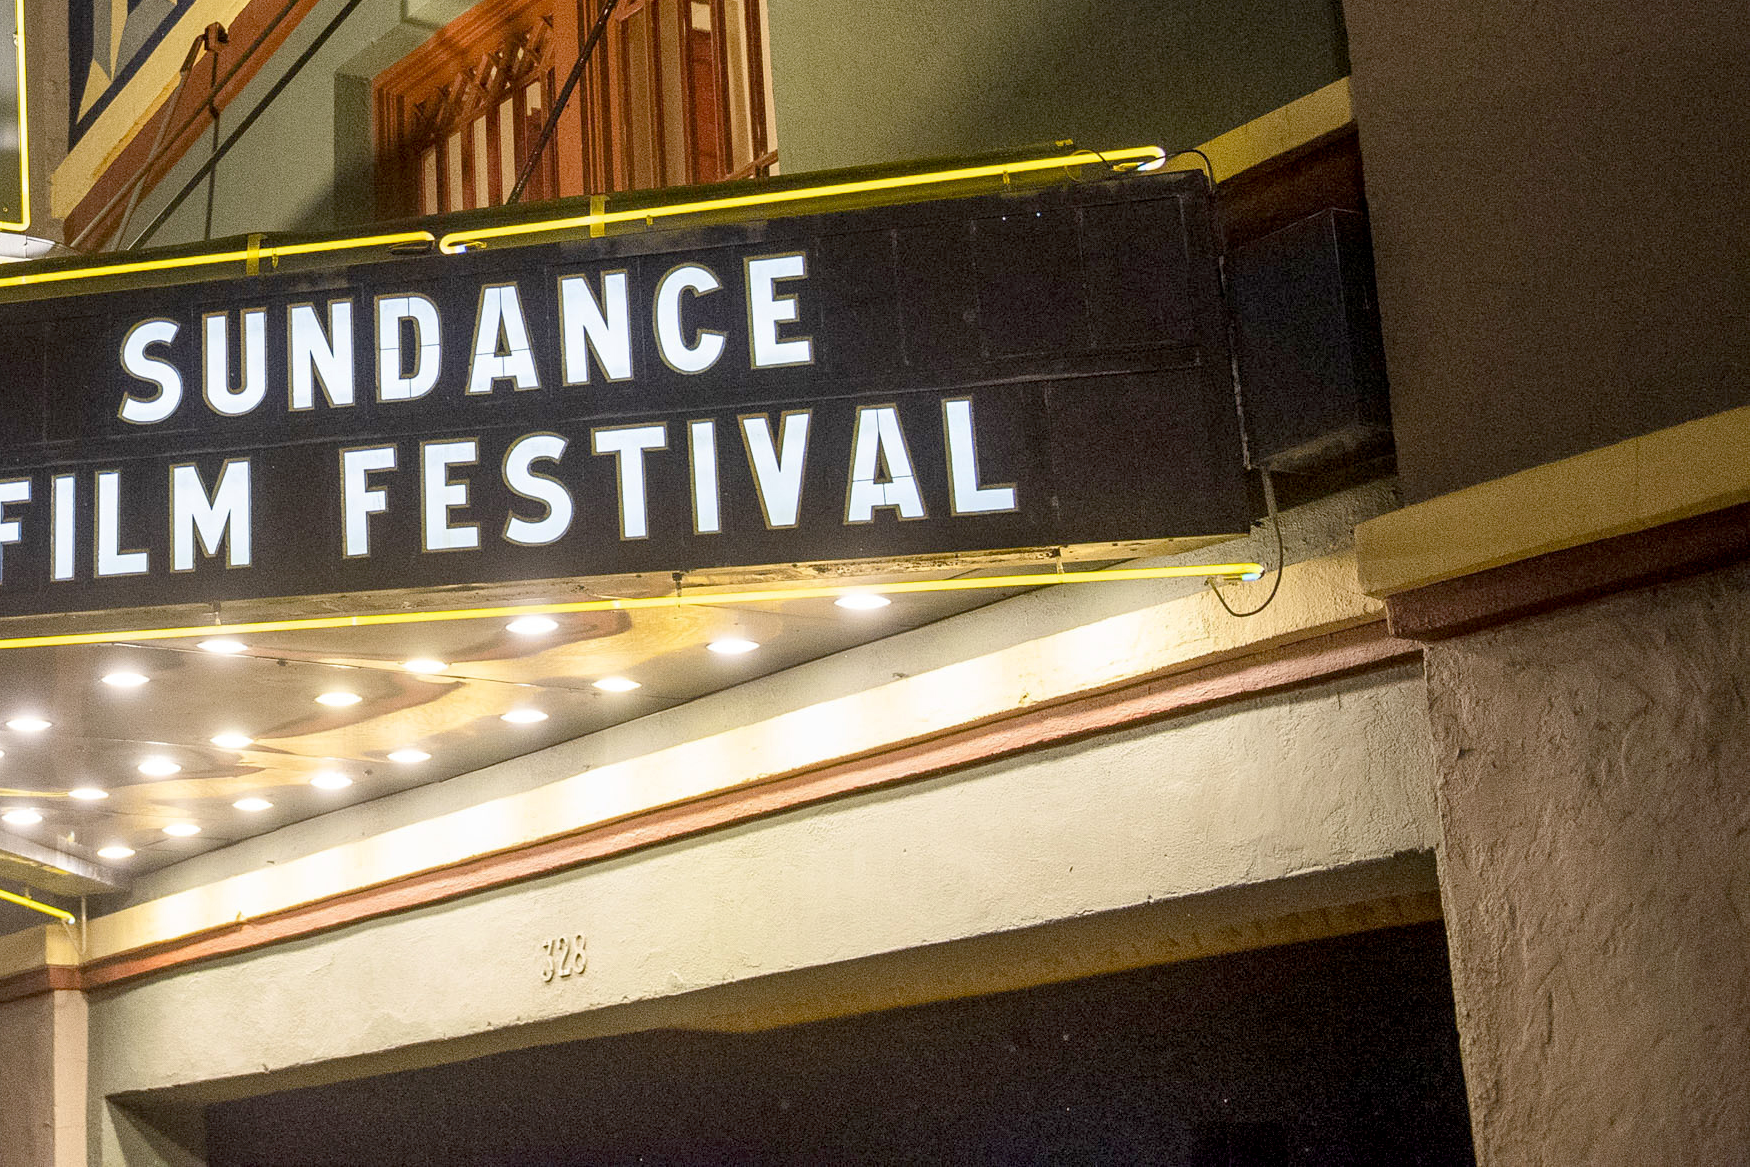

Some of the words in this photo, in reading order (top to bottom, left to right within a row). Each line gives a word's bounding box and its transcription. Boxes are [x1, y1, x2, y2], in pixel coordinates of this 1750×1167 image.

[118, 252, 815, 426] SUNDANCE
[343, 395, 1018, 560] FESTIVAL
[541, 933, 587, 983] 328
